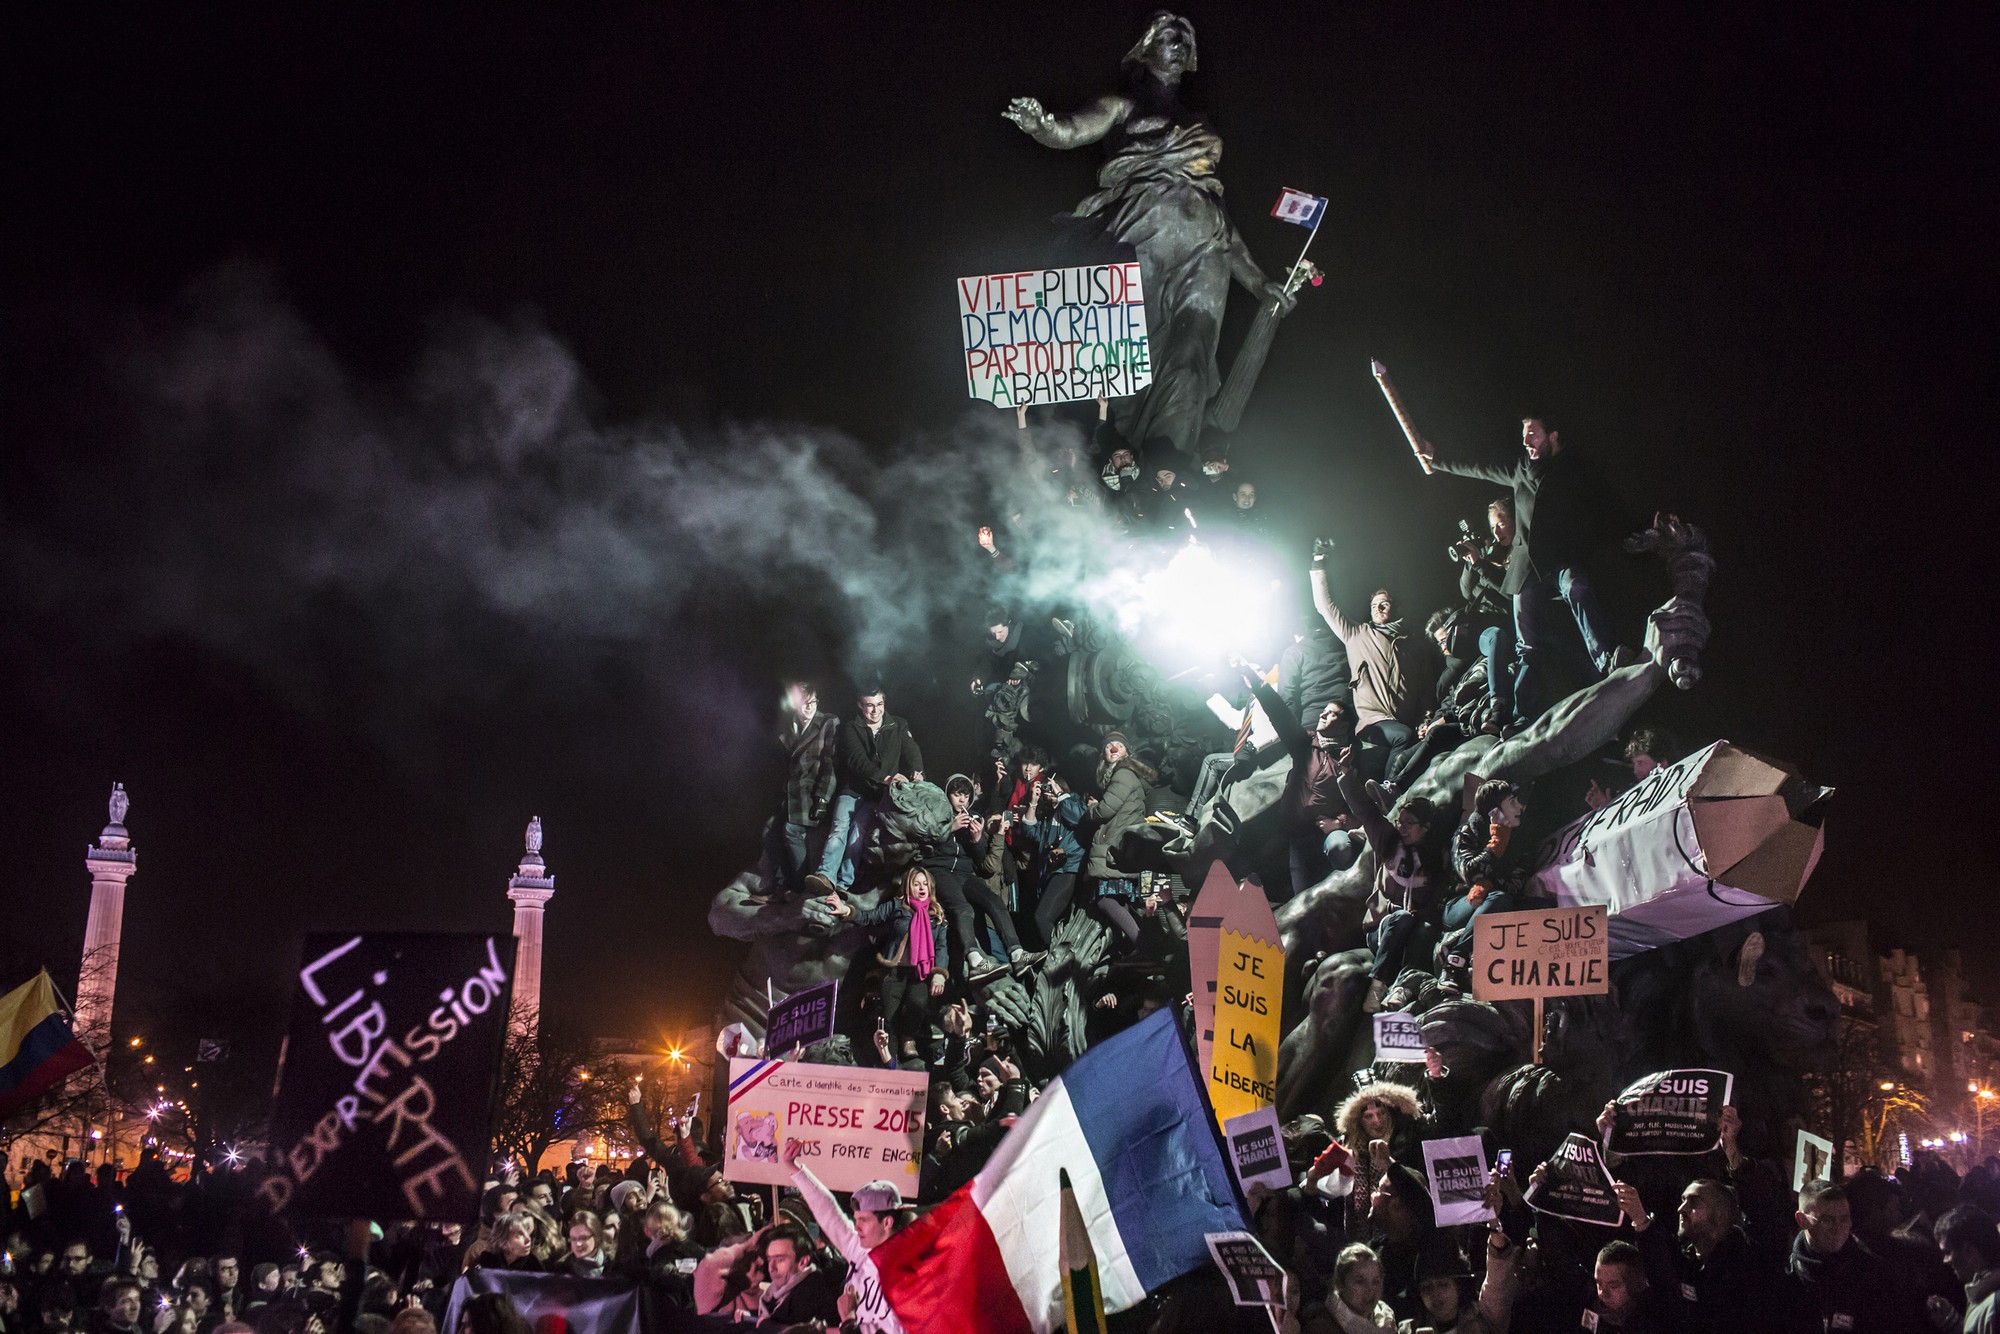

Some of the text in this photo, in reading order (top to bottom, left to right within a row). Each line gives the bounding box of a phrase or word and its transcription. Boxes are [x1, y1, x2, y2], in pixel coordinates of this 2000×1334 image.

[1043, 267, 1109, 307] PLUS
[1108, 264, 1144, 304] DE
[967, 336, 1150, 380] PARTOUT CONTRE
[1563, 764, 1685, 854] AFRAID
[1489, 922, 1530, 950] JE
[1233, 951, 1265, 980] JE
[1487, 959, 1602, 986] CHARLIE
[772, 997, 827, 1030] JE SUIS
[770, 1010, 827, 1049] CHARLIE
[1382, 1022, 1400, 1033] JE
[1230, 1028, 1257, 1056] LA
[767, 1075, 802, 1088] Carte
[847, 1083, 863, 1092] des
[868, 1084, 926, 1097] Journalistes
[1658, 1079, 1709, 1095] SUIS
[787, 1102, 922, 1134] PRESSE 2015
[831, 1144, 873, 1159] FORTE
[1236, 1136, 1276, 1155] JE SUIS
[1237, 1145, 1279, 1166] CHARLIE
[1569, 1143, 1594, 1164] SUIS
[1435, 1166, 1481, 1179] JE SUIS
[1437, 1176, 1484, 1191] CHARLIE
